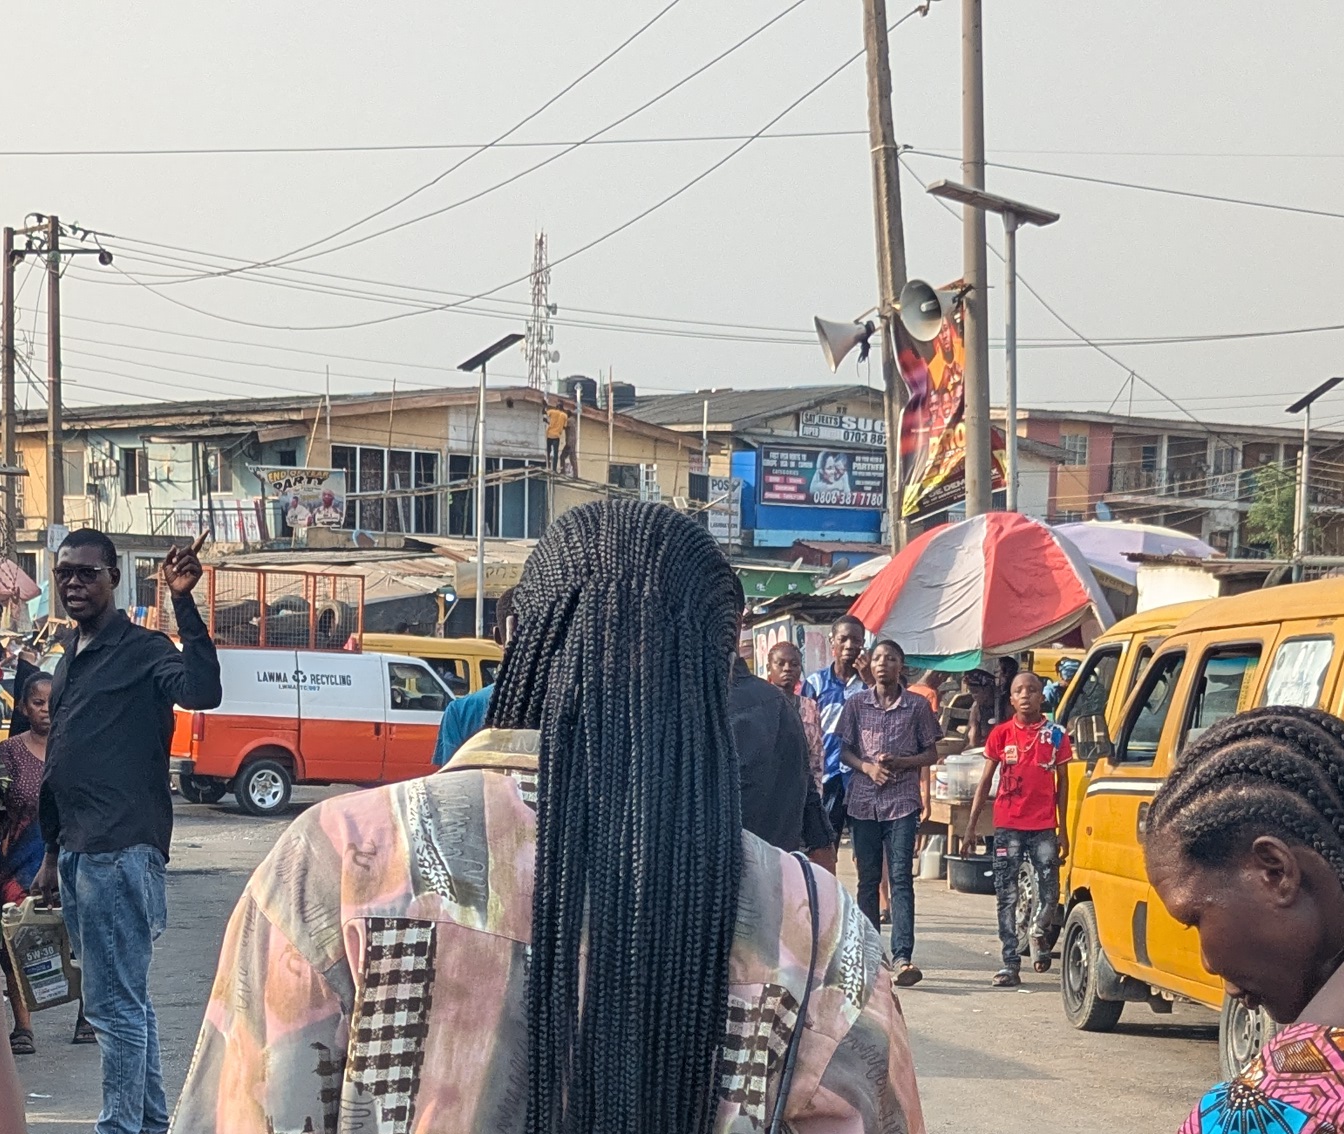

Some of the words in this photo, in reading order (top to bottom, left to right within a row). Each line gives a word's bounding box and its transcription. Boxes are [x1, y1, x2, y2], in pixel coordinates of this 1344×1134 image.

[843, 430, 868, 443] 0703
[267, 471, 287, 482] END
[306, 470, 330, 480] YEAR
[273, 476, 328, 493] PARTY
[711, 479, 729, 491] POS
[257, 671, 288, 683] LAWMA
[310, 673, 352, 686] RECYCLING
[26, 946, 55, 961] 5W-30
